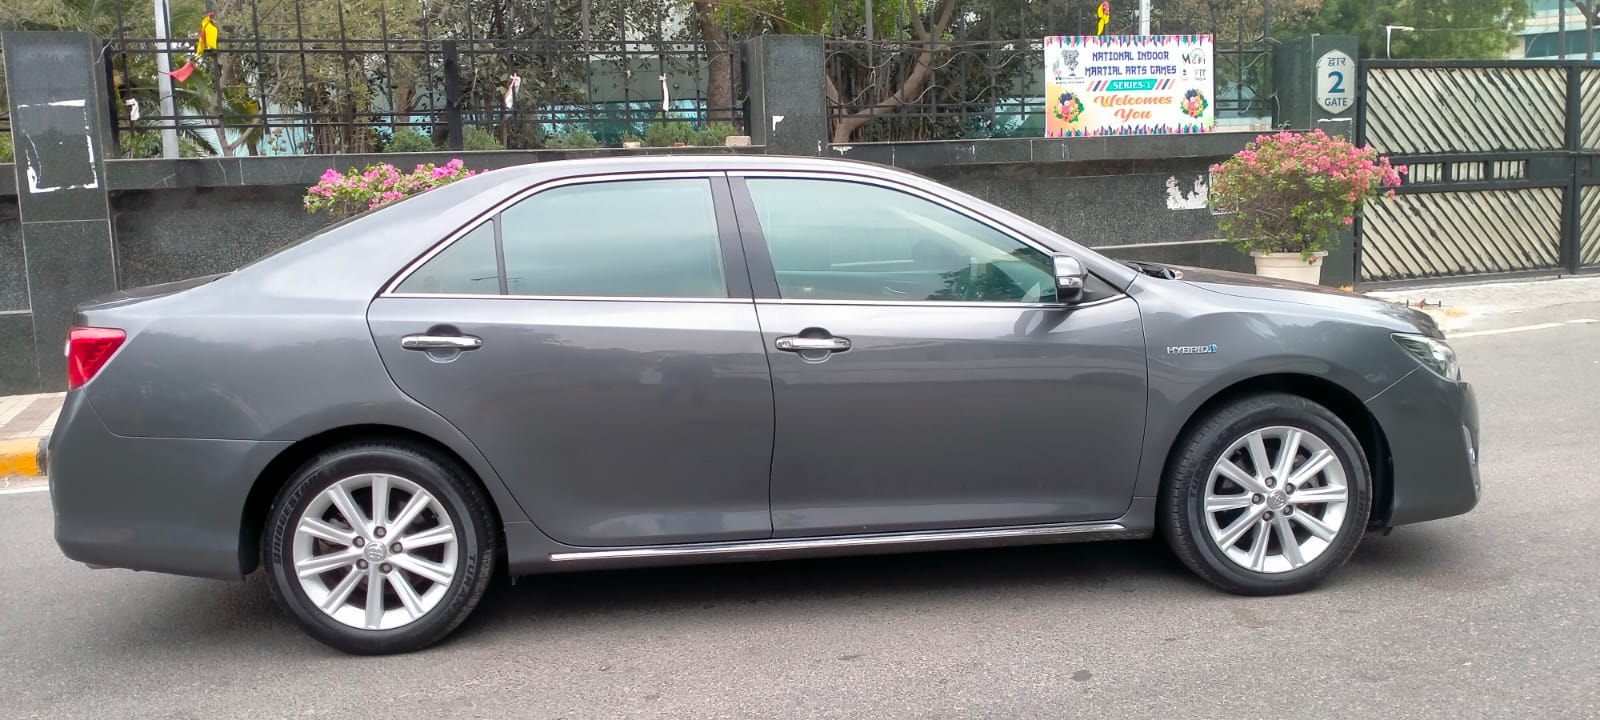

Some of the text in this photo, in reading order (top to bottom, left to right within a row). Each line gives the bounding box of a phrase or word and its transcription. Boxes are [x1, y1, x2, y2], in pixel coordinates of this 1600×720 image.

[1092, 50, 1169, 61] NATIONAL INDOOR
[1327, 57, 1346, 67] द्वार
[1084, 65, 1177, 77] MARTIAL ARTS GAMES
[1327, 70, 1345, 93] 2
[1093, 94, 1173, 107] Welcomes
[1324, 97, 1347, 106] GATE
[1114, 108, 1152, 122] You
[1167, 345, 1209, 354] HYBRID
